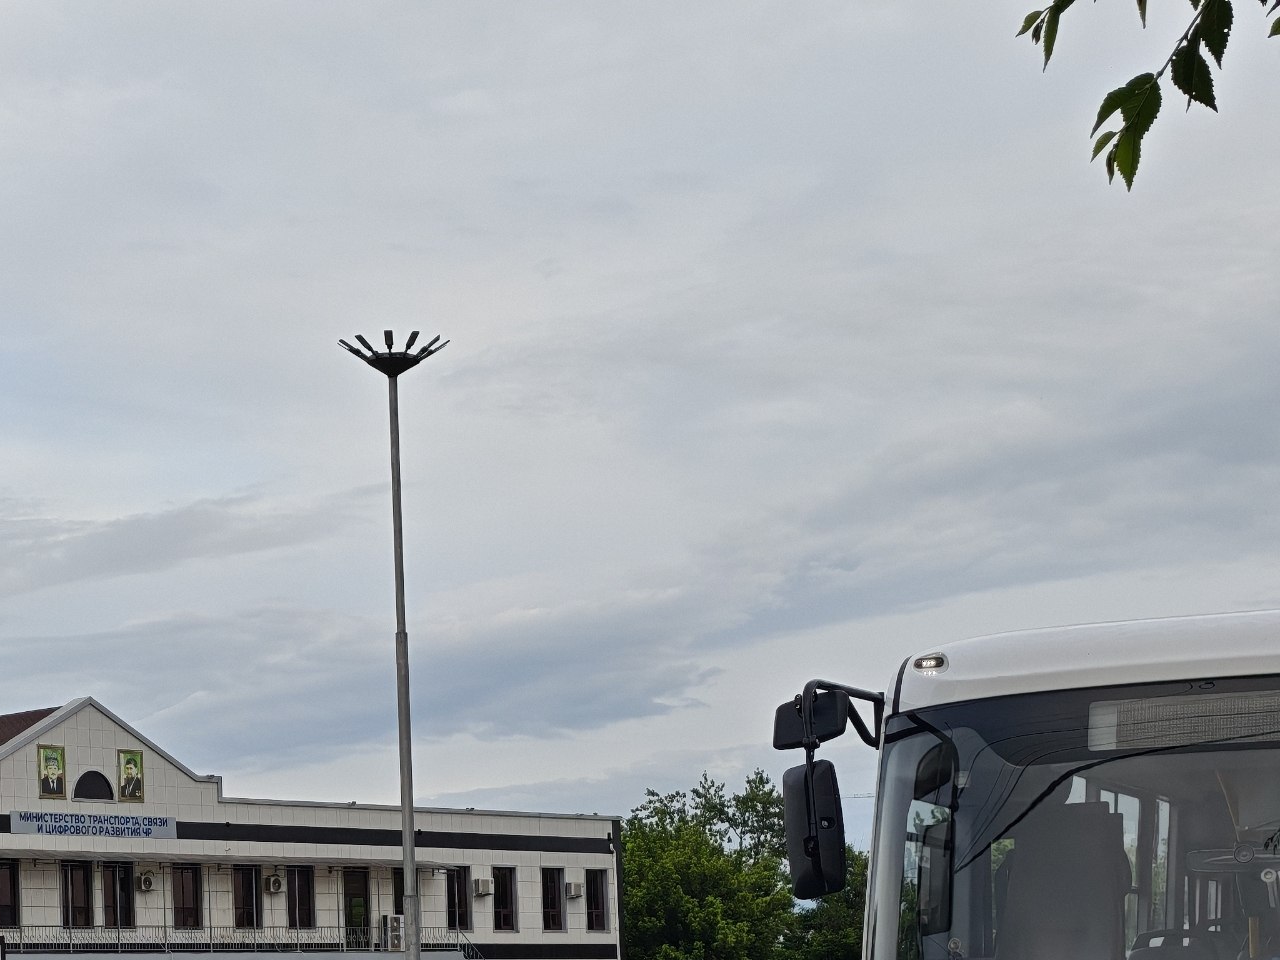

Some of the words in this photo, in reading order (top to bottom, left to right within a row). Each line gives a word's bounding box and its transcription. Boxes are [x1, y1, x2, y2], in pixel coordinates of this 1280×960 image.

[19, 812, 86, 825] МИНИСТЕРСТВО
[88, 815, 141, 827] ТРАНСПОРТА,
[142, 817, 168, 828] СВЯЗИ
[37, 824, 44, 834] И
[45, 824, 97, 836] ЦИФРОВОГО
[98, 826, 141, 837] РАЗВИТИЯ
[143, 828, 152, 837] ЧР
